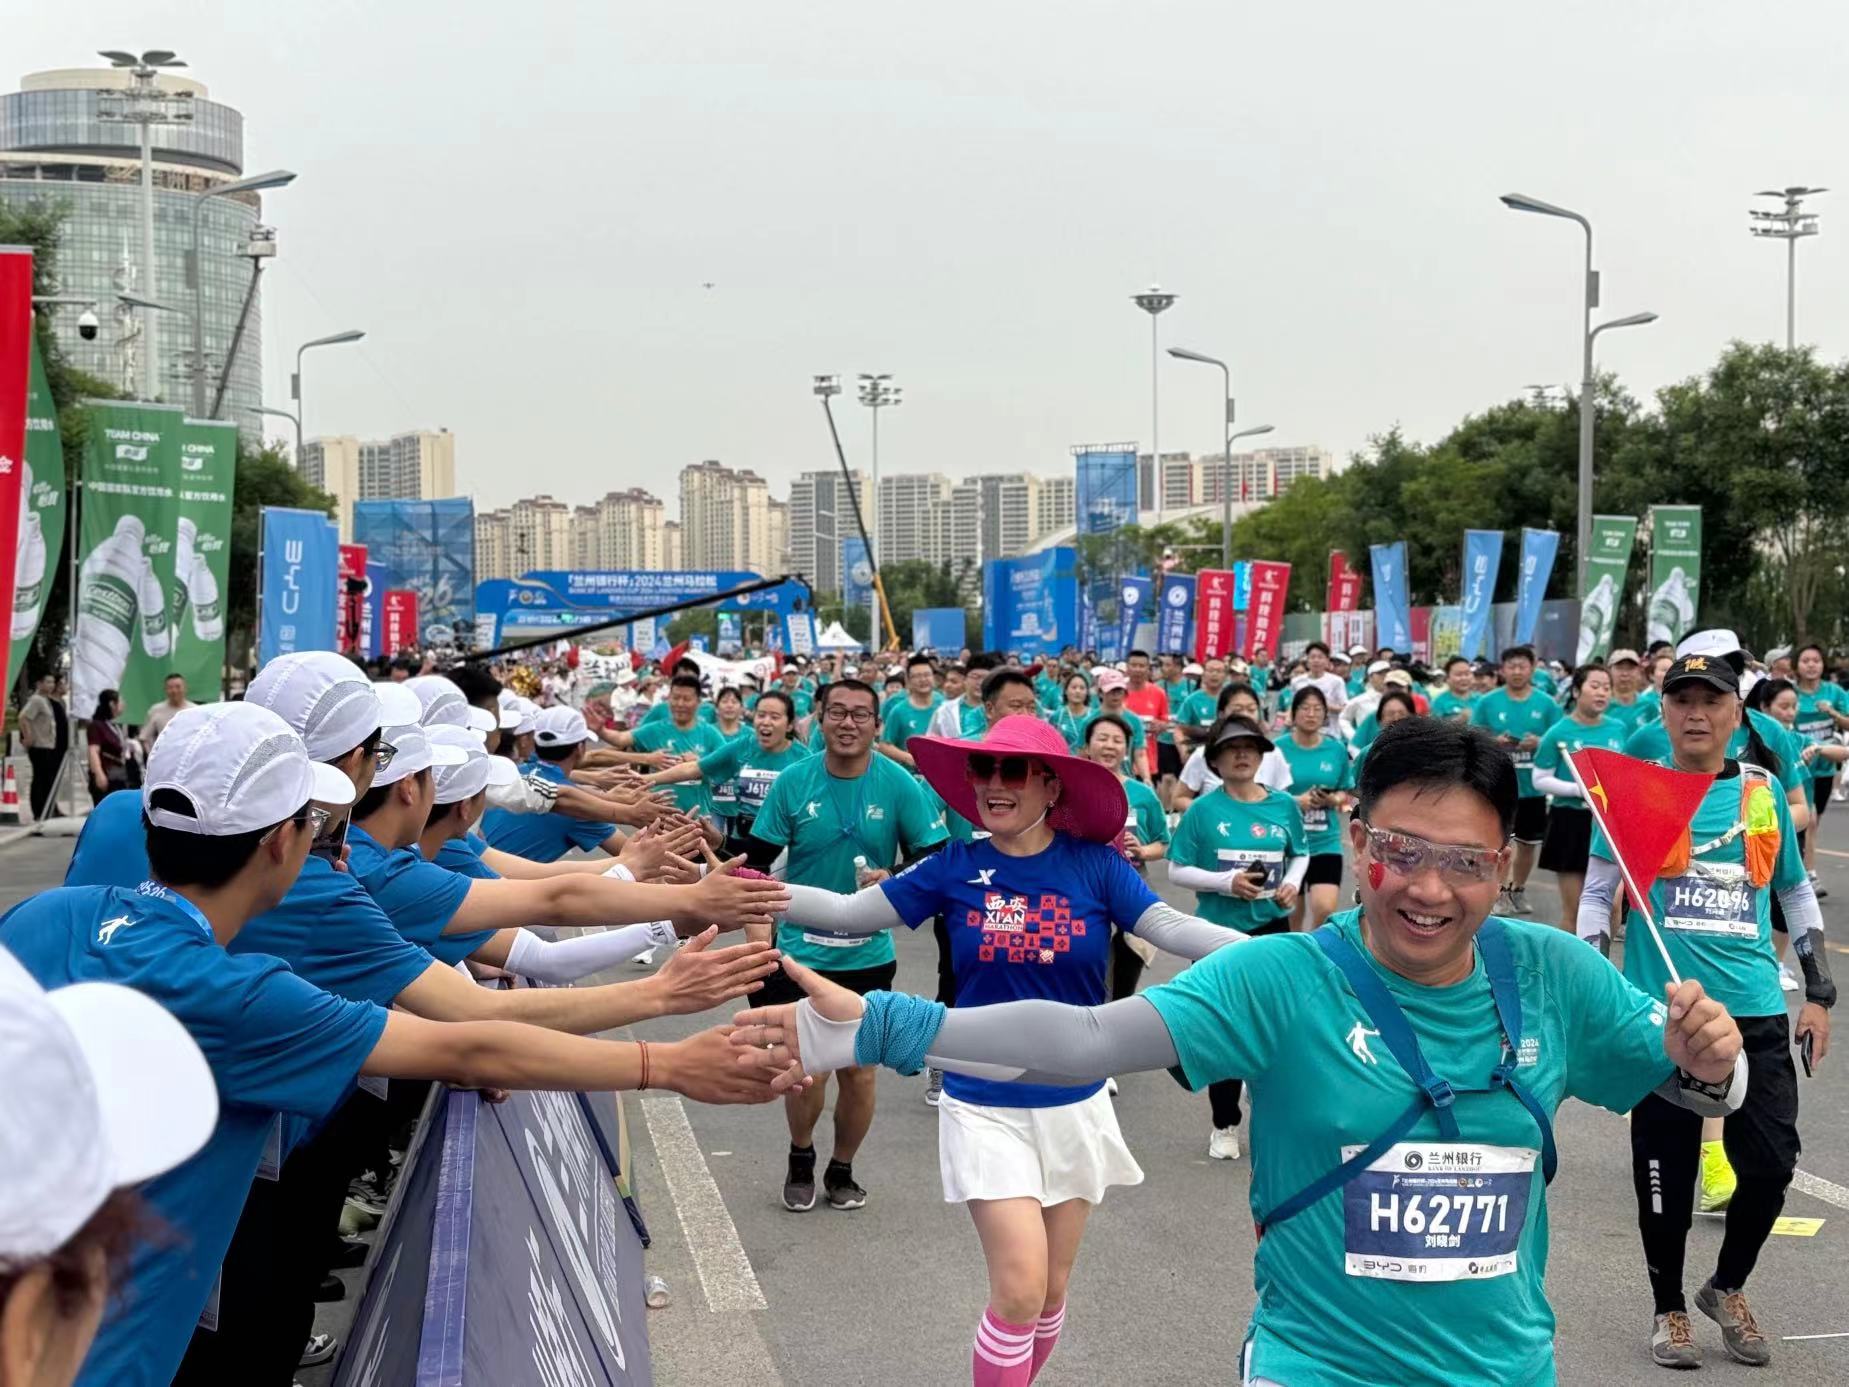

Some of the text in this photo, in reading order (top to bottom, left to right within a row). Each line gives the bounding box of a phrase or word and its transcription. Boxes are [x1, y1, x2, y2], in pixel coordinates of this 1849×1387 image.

[132, 432, 160, 442] CHINA
[282, 540, 303, 614] BYD
[1463, 555, 1488, 614] BYD
[985, 909, 1025, 924] XI'AN
[1428, 1151, 1482, 1166] 兰州银行
[1370, 1192, 1509, 1234] H62771
[1363, 1260, 1402, 1272] BYD
